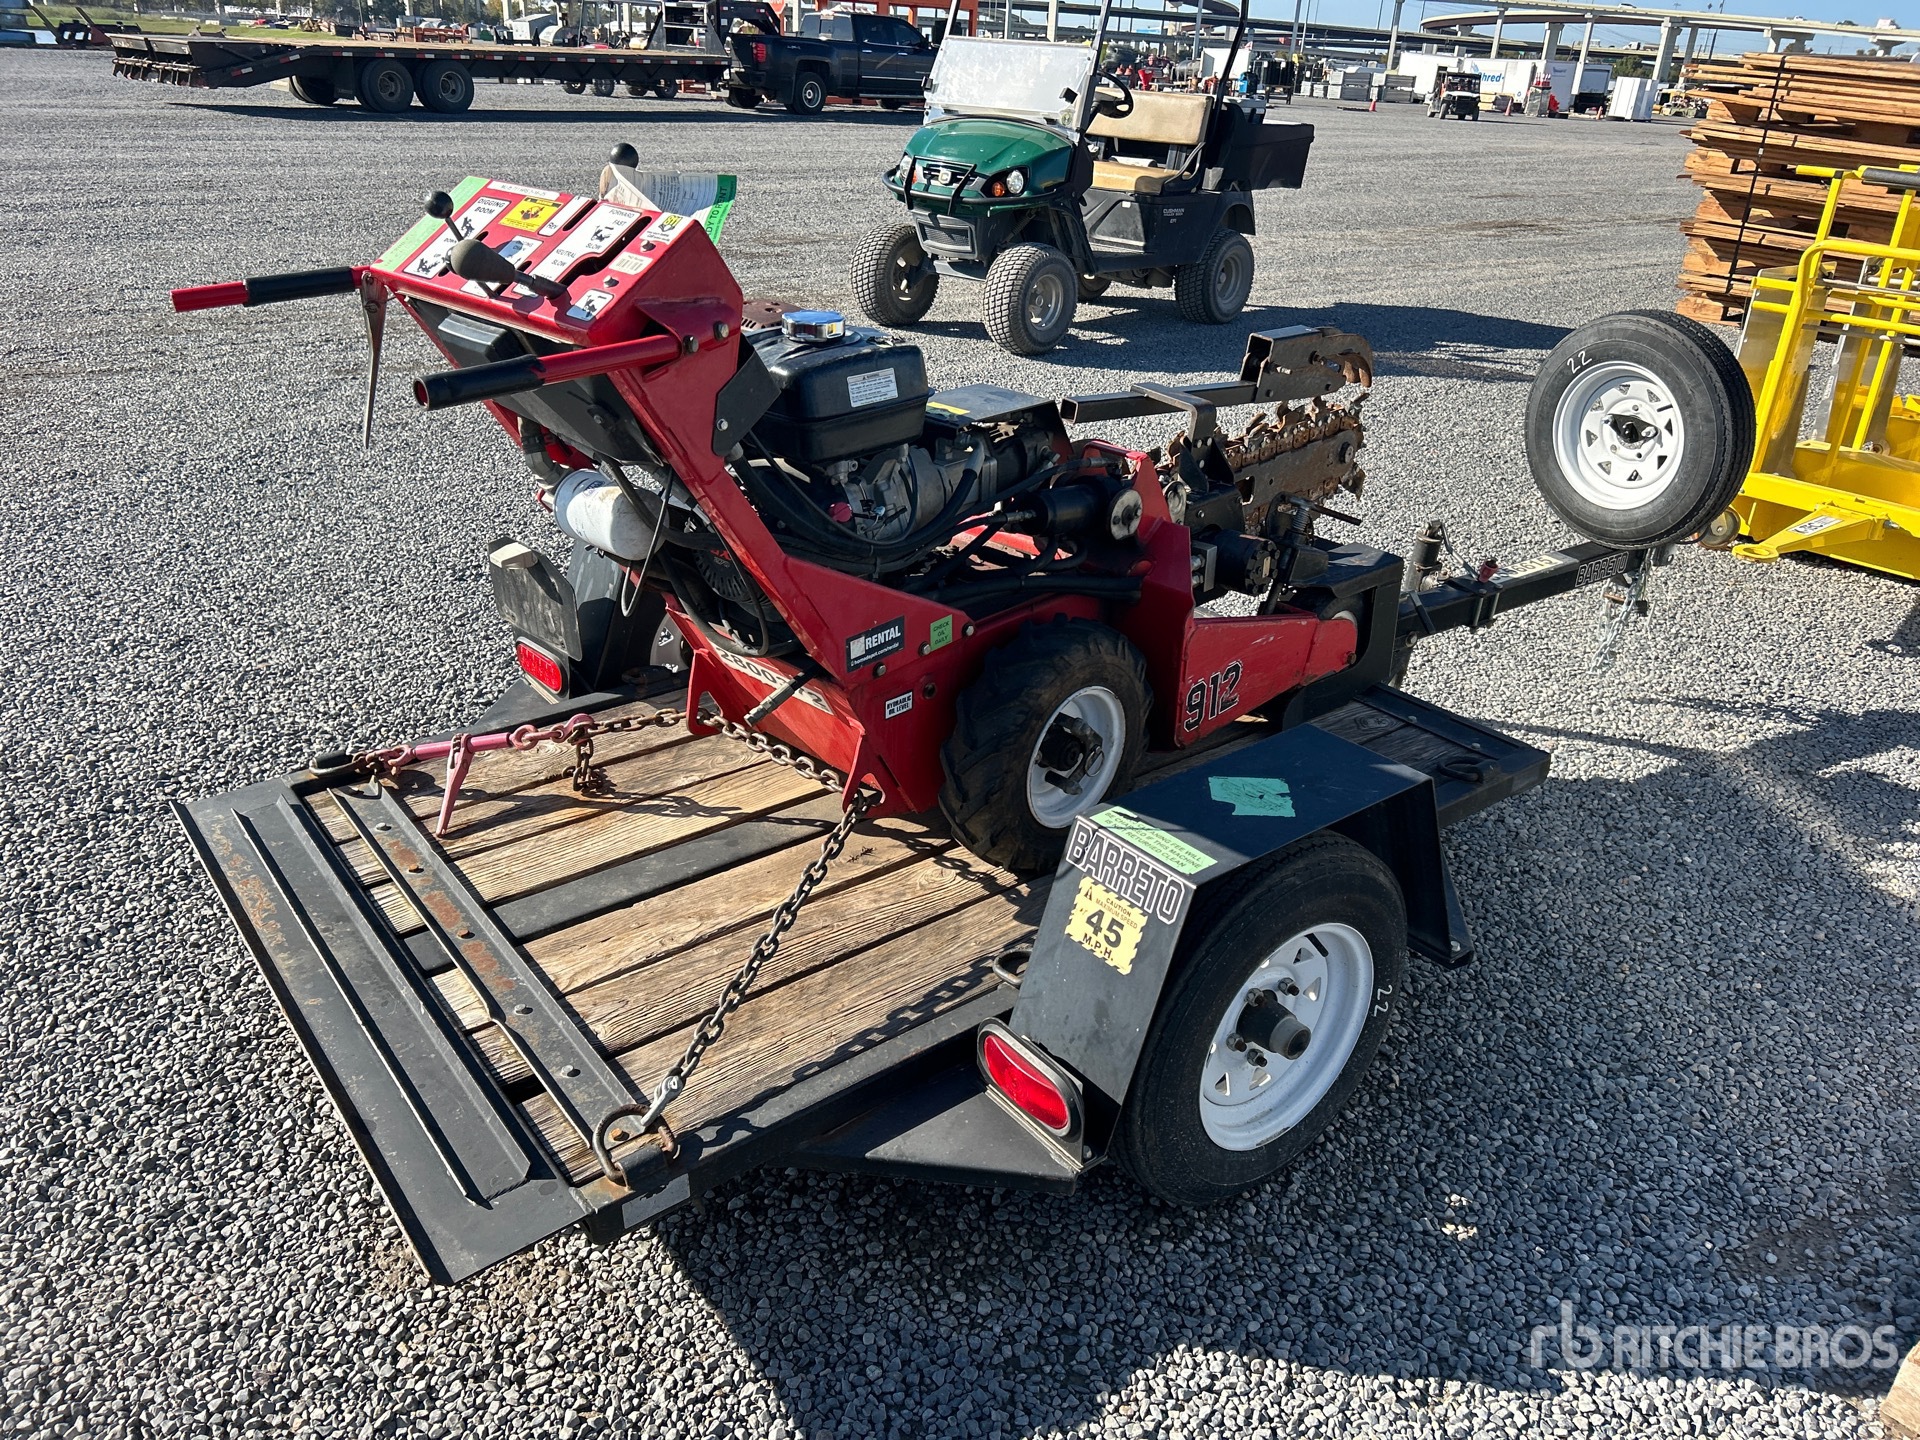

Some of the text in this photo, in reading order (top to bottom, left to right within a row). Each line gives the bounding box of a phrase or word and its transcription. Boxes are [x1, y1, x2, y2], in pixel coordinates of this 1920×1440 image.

[474, 206, 495, 214] BOOM
[477, 198, 506, 208] DIGGING
[609, 209, 635, 218] FORWARD
[710, 210, 719, 220] TO
[715, 188, 728, 208] RENT
[612, 219, 627, 227] FAST
[555, 248, 577, 259] NEUTRAL
[585, 242, 602, 250] SLOW
[551, 259, 567, 267] SLOW
[1567, 350, 1592, 374] 22
[1575, 551, 1629, 588] BARRETO
[933, 620, 950, 632] CHECK
[865, 625, 901, 650] RENTAL
[934, 635, 948, 646] DAILY
[886, 695, 911, 710] HYDRAULIC
[1183, 659, 1243, 733] 912
[888, 703, 910, 716] OIL LEVEL
[1105, 811, 1114, 820] BE
[1153, 838, 1170, 850] THIS
[1169, 847, 1201, 869] MACHINE
[1125, 830, 1162, 854] RETURNED
[1161, 850, 1187, 868] CLEAN
[1170, 840, 1183, 851] FEE
[1183, 849, 1202, 862] WILL
[1066, 819, 1186, 925] BARRETO
[1095, 897, 1138, 930] MAXIMUM SPEED
[1105, 896, 1132, 917] CAUTION
[1085, 908, 1125, 948] 45
[1082, 932, 1114, 962] M.P.H.
[1373, 984, 1393, 1017] 22
